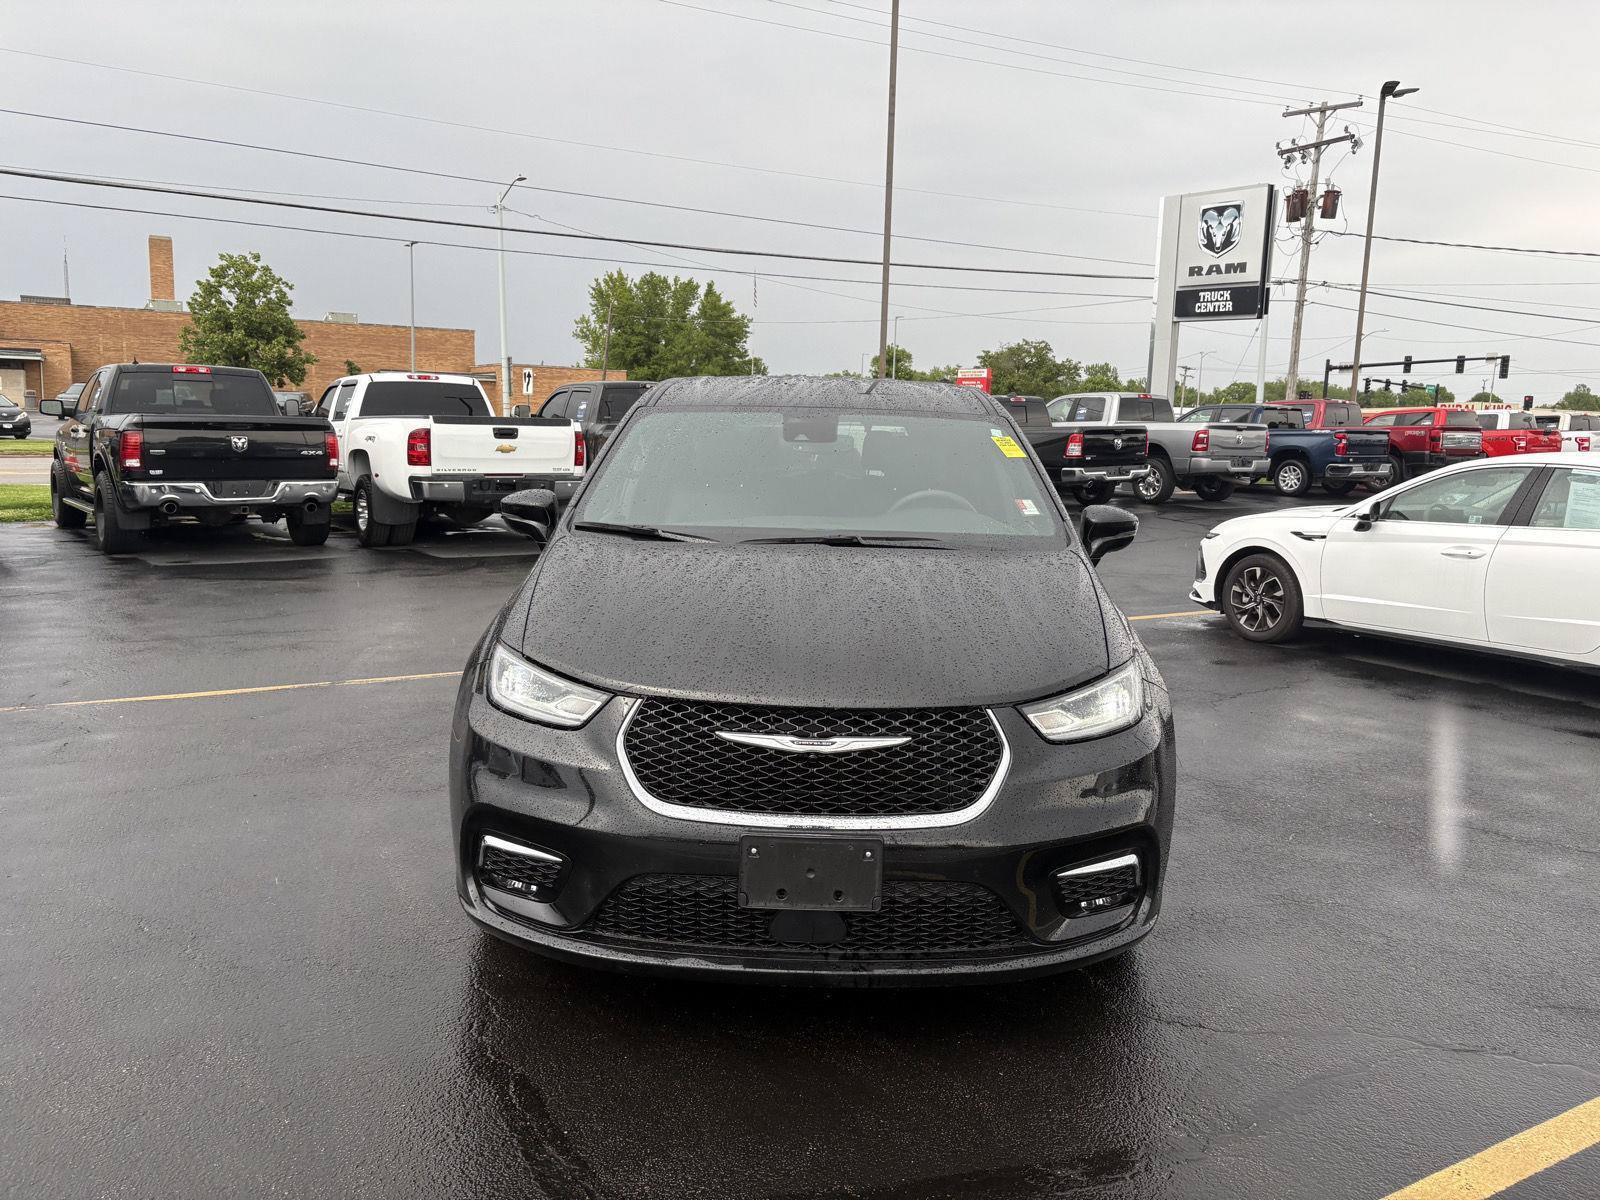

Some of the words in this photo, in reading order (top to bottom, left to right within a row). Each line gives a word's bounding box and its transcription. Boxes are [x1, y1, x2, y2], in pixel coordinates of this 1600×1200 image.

[1188, 262, 1248, 277] RAM
[1199, 291, 1231, 302] TRUCK
[1195, 302, 1233, 313] CENTER
